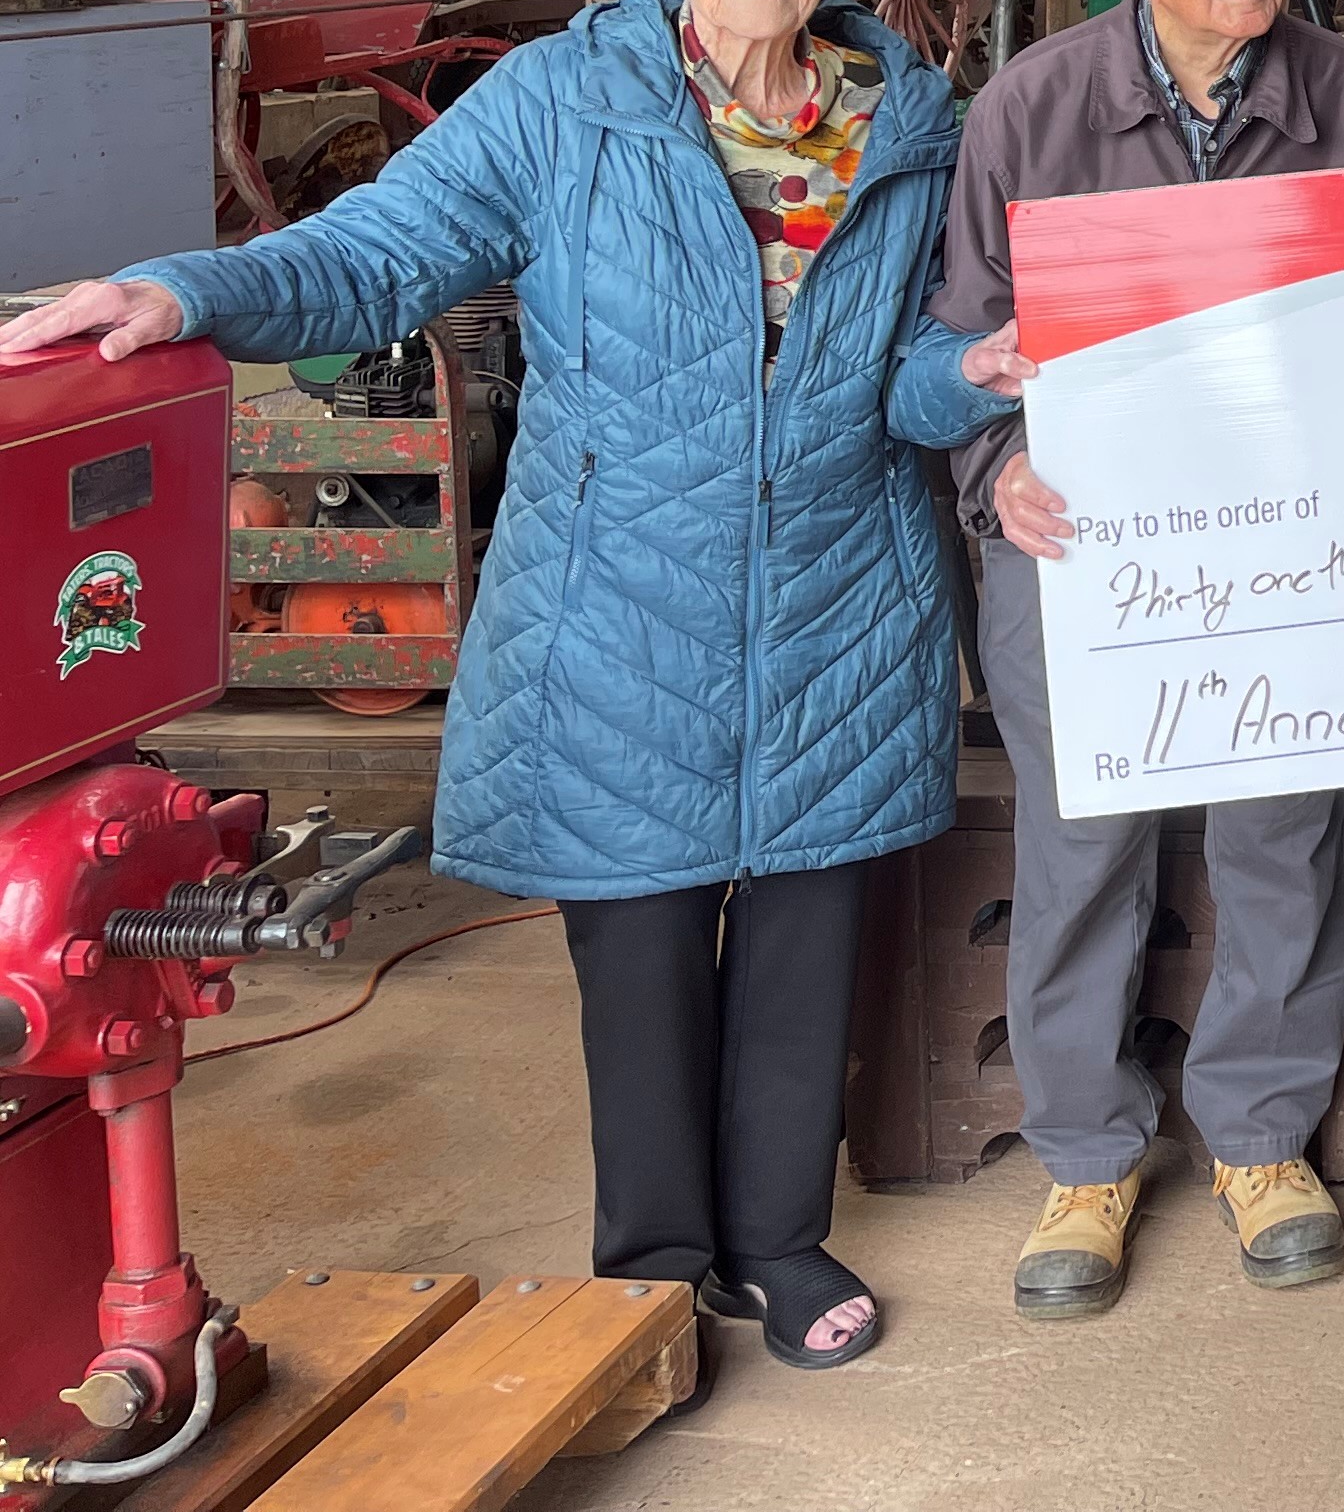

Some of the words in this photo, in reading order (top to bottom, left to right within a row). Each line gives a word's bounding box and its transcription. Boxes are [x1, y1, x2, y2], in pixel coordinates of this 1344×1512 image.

[1075, 515, 1125, 548] Pay
[1134, 513, 1159, 539] to
[1166, 505, 1208, 535] the
[1216, 496, 1287, 529] order
[1294, 489, 1320, 519] of
[1108, 560, 1234, 632] Thirty
[1249, 569, 1314, 596] one
[84, 627, 125, 649] TALES
[1094, 752, 1131, 782] Re
